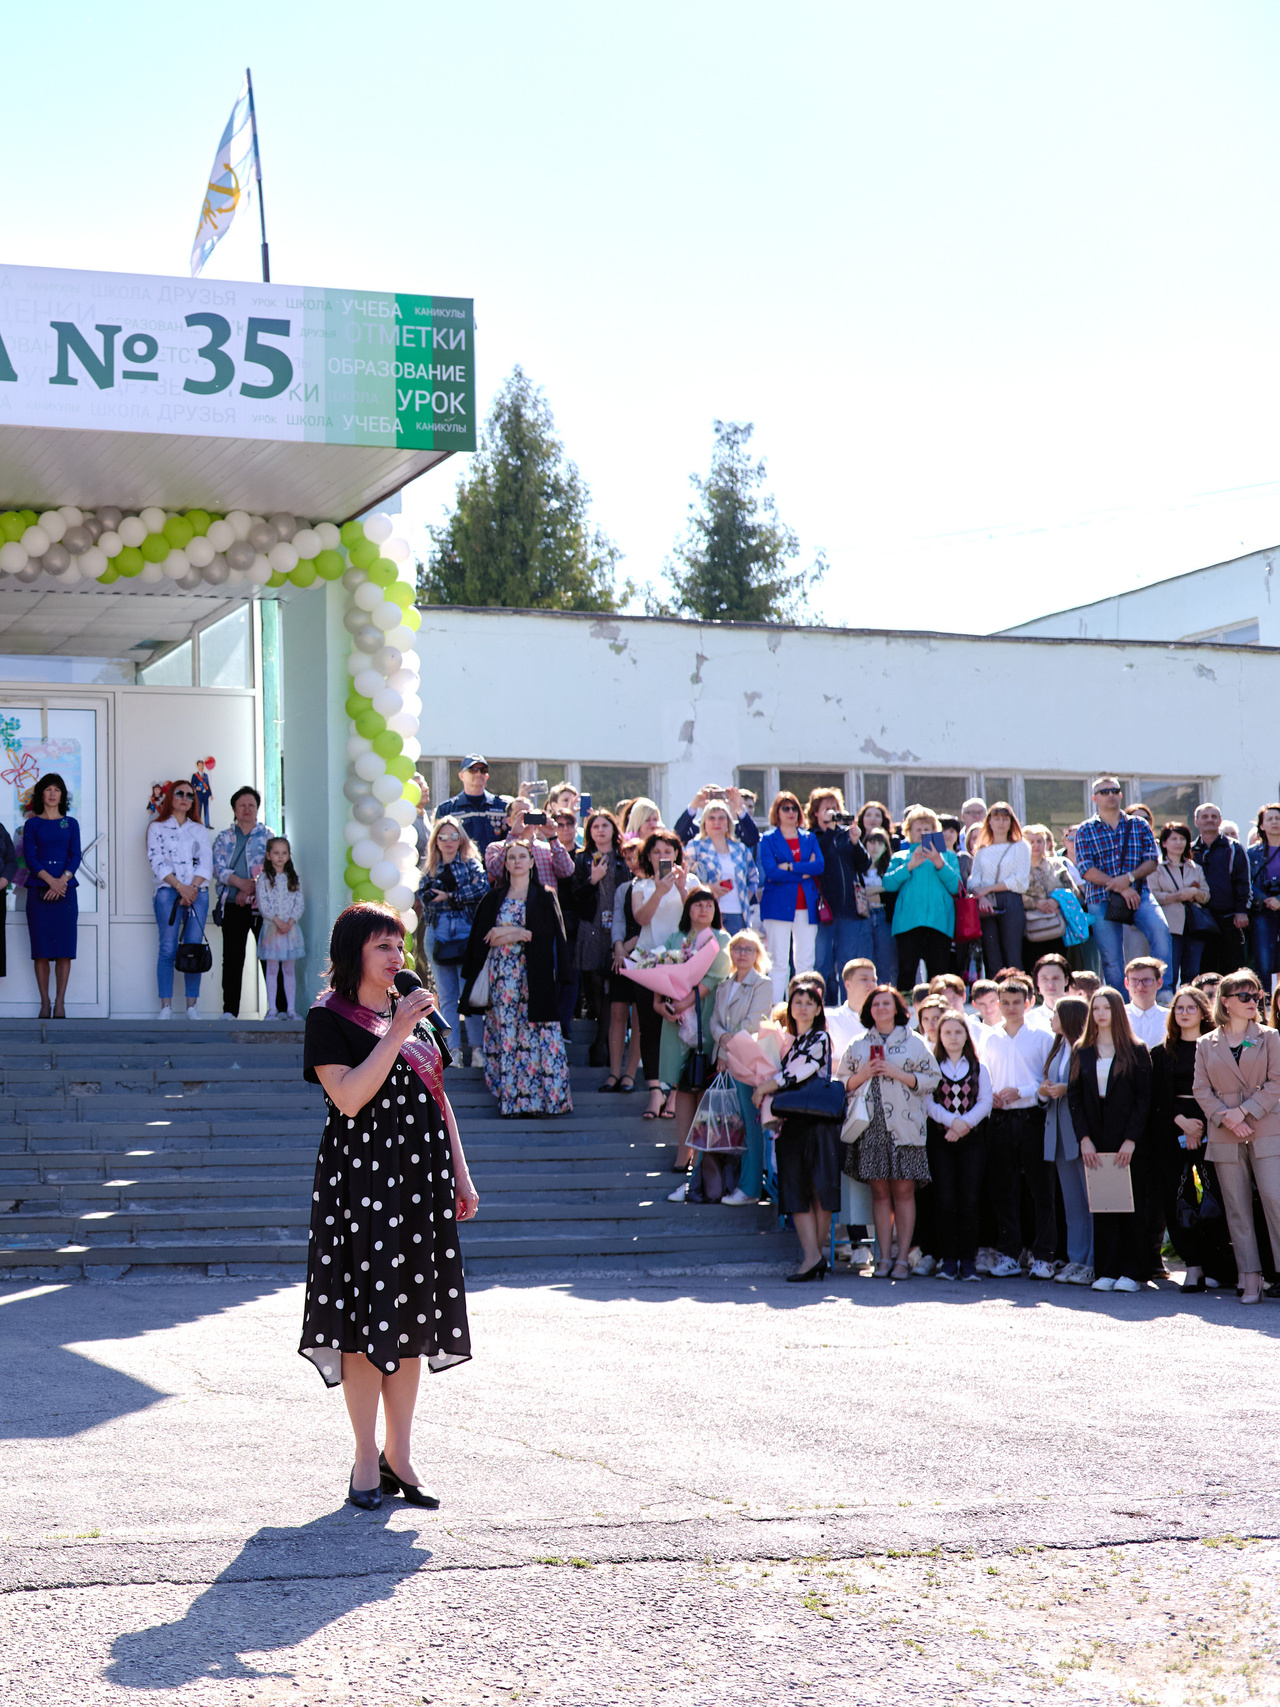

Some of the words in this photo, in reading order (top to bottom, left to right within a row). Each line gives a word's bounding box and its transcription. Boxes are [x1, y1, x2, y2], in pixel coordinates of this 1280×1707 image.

[91, 283, 151, 300] ШКОЛА
[157, 285, 236, 307] ДРУЗЬЯ
[252, 297, 277, 308] УРОК
[285, 296, 333, 312] ШКОЛА
[341, 297, 403, 319] УЧЕБА
[414, 306, 466, 319] КАНИКУЛЫ
[344, 321, 466, 351] ОТМЕТКИ
[49, 320, 159, 390] №
[182, 311, 294, 399] 35
[328, 357, 466, 383] ОБРАЗОВАНИЕ
[396, 388, 467, 415] УРОК
[90, 402, 150, 419] ШКОЛА
[157, 403, 236, 424] ДРУЗЬЯ
[252, 413, 277, 424] УРОК
[285, 412, 334, 428] ШКОЛА
[342, 414, 404, 435] УЧЕБА
[415, 420, 467, 434] КАНИКУЛЫ
